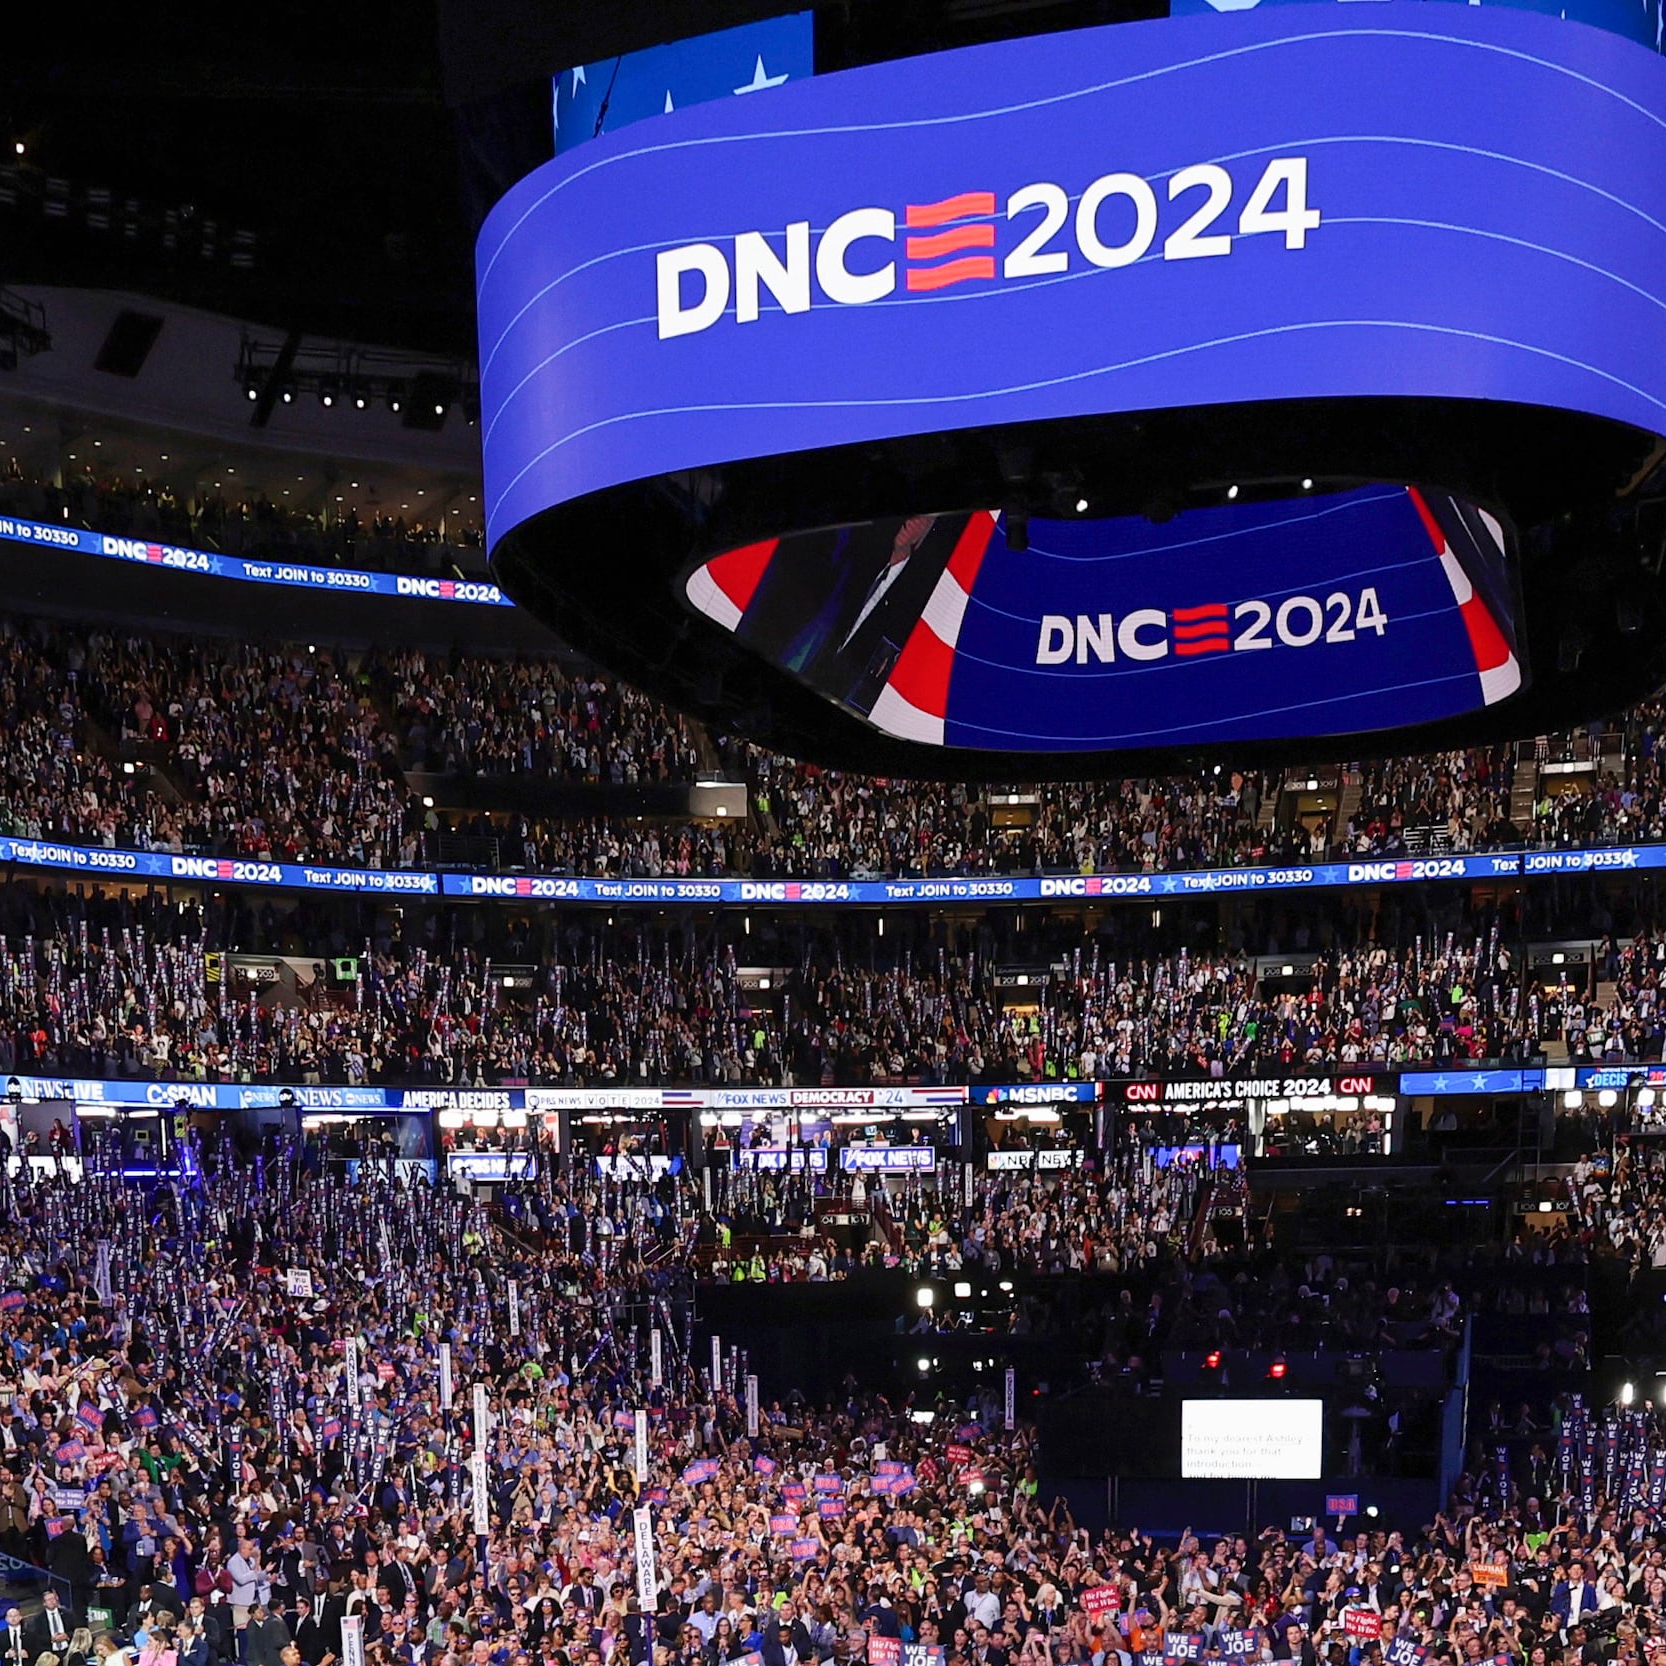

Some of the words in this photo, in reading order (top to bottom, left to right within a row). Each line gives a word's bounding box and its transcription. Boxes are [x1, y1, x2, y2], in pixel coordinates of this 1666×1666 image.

[657, 208, 895, 339] DNC
[1004, 158, 1320, 278] 2024
[102, 536, 148, 561] DNC
[162, 547, 210, 571] 2024
[1036, 609, 1168, 664] DNC
[1234, 587, 1388, 651] 2024
[171, 856, 218, 878] DNC
[233, 862, 283, 882] 2024
[1348, 862, 1397, 882] DNC
[1411, 859, 1466, 878] 2024
[471, 876, 517, 895] DNC
[531, 879, 580, 897] 2024
[594, 883, 623, 897] Text
[624, 884, 658, 897] JOIN
[660, 885, 675, 897] to
[677, 884, 721, 897] 30330
[740, 882, 787, 900] DNC
[800, 882, 850, 901] 2024
[1040, 878, 1086, 896] DNC
[1101, 876, 1152, 894] 2024
[1009, 1085, 1078, 1103] MSNBC
[1126, 1085, 1157, 1100] CNN
[1164, 1081, 1232, 1100] AMERICA'S
[1234, 1079, 1281, 1097] CHOICE
[1283, 1077, 1332, 1096] 2024
[1339, 1077, 1372, 1093] CNN
[295, 1089, 342, 1106] NEWS
[402, 1089, 457, 1109] AMERICA
[459, 1090, 511, 1109] DECIDES
[558, 1096, 582, 1106] NEWS
[634, 1095, 660, 1105] 2024
[725, 1092, 751, 1105] FOX
[752, 1093, 787, 1105] NEWS
[792, 1090, 872, 1105] DEMOCRACY
[856, 1151, 883, 1167] FOX
[885, 1150, 931, 1167] NEWS
[347, 1346, 357, 1396] KANSAS
[474, 1462, 485, 1522] MINNESOTA
[638, 1522, 653, 1596] DELAWARE
